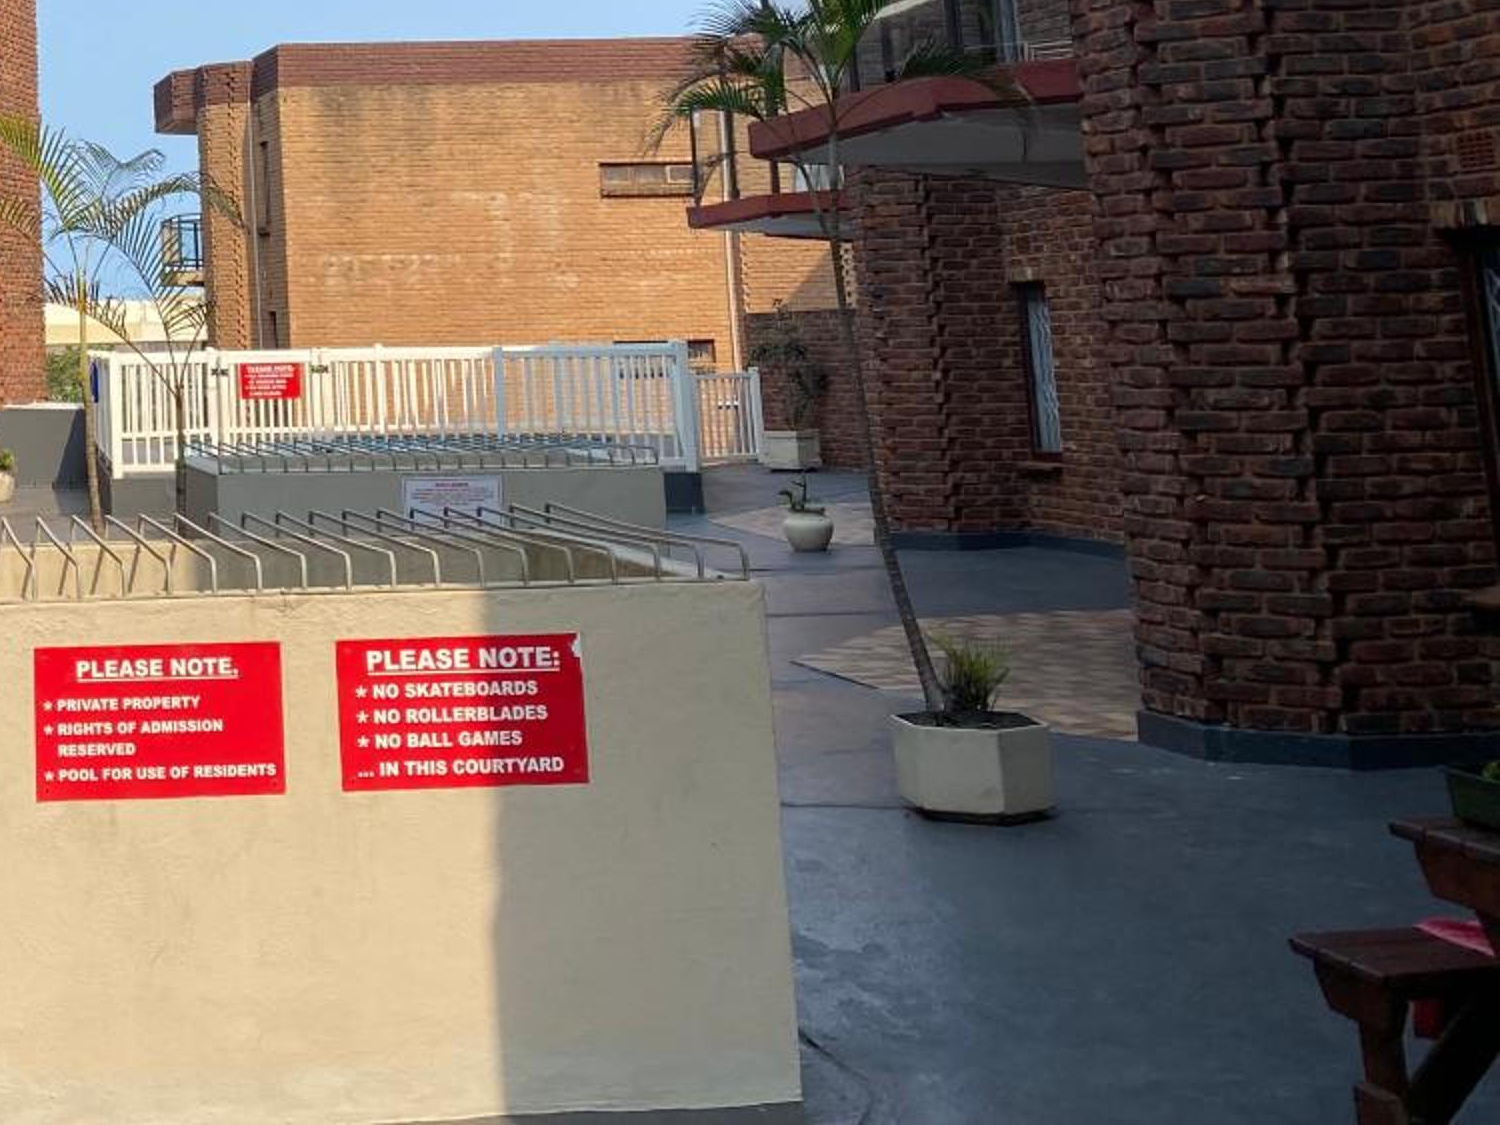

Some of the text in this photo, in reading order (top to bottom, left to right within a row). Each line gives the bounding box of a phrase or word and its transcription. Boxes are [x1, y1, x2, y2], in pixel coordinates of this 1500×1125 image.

[366, 646, 560, 671] PLEASE NOTE:
[76, 658, 164, 678] PLEASE
[372, 681, 538, 698] NO SKATEBOARDS
[57, 696, 200, 712] PRIVATE PROPERTY
[373, 705, 548, 723] NO ROLLERBLADES
[58, 719, 223, 736] RIGHTS OF ADMISSION
[375, 731, 522, 748] NO BALL GAMES
[58, 742, 136, 757] RESERVED
[58, 764, 277, 782] POOL FOR USE OF RESIDENTS
[379, 762, 399, 776] IN
[404, 760, 447, 775] THIS
[453, 757, 564, 774] COURTYARD
